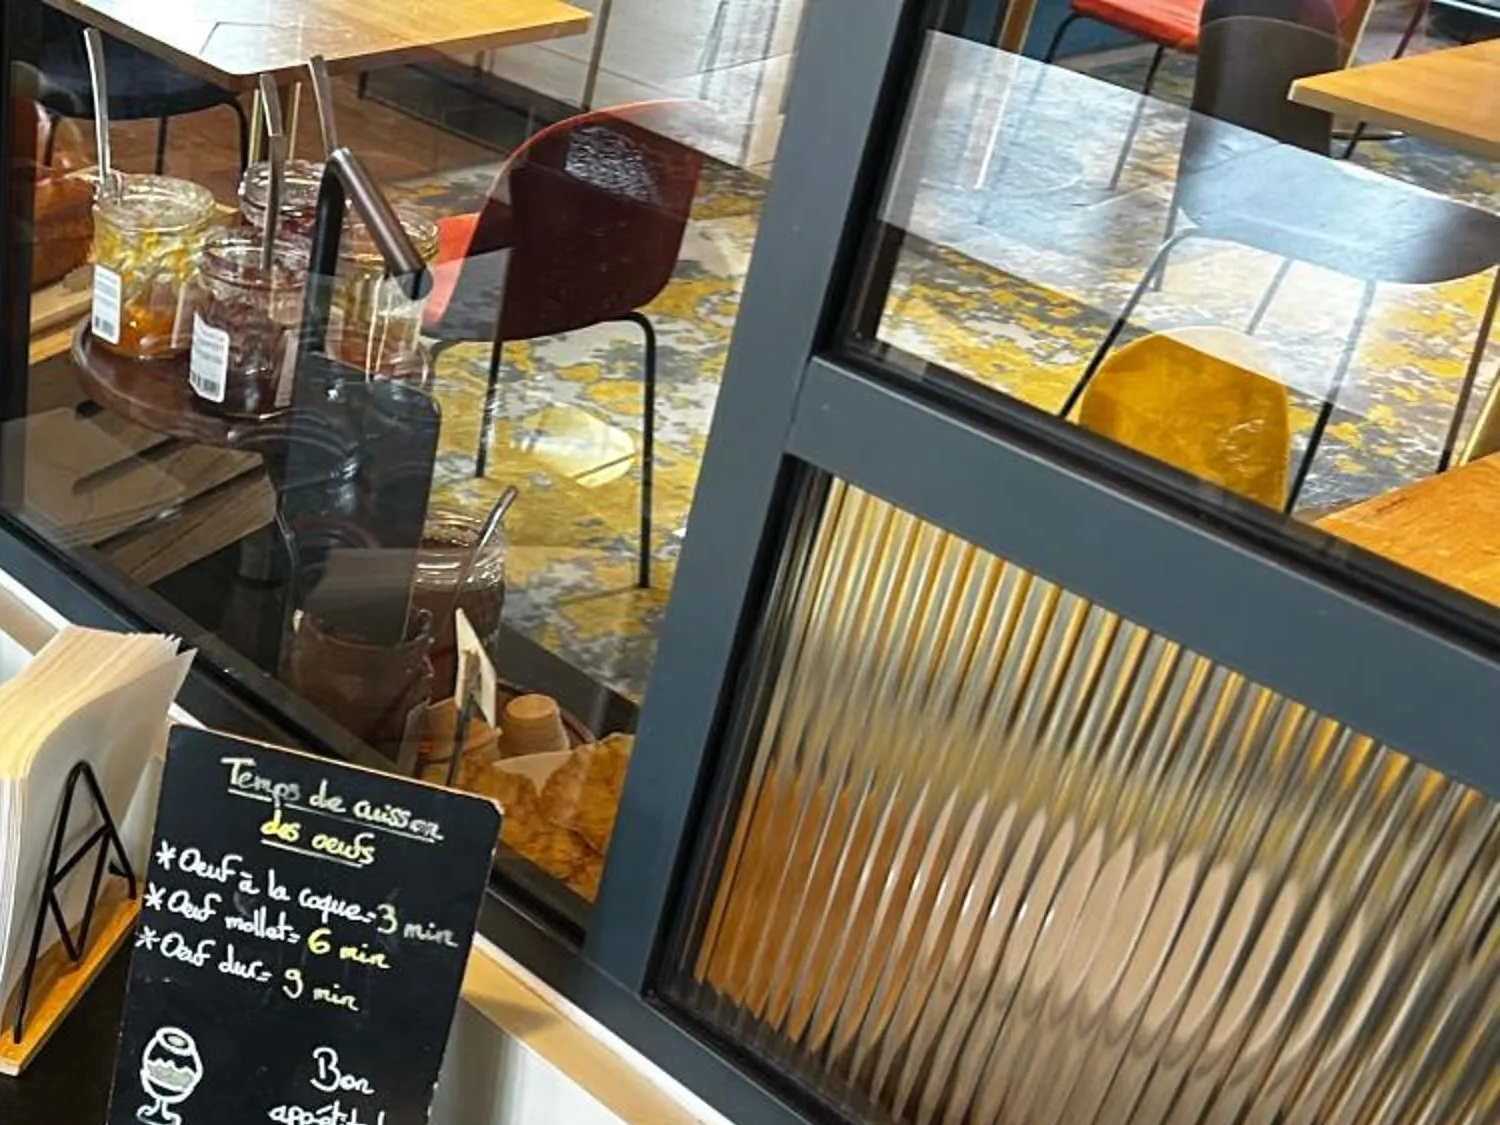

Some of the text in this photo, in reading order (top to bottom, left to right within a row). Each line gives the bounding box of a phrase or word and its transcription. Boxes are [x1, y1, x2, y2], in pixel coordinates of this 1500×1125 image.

[220, 757, 444, 841] Temps de cuisson
[260, 808, 375, 865] des oeufs
[268, 868, 291, 901] la
[403, 921, 459, 948] min
[307, 927, 332, 955] 6
[339, 943, 392, 969] min
[282, 968, 303, 999] 9
[312, 983, 360, 1012] min
[310, 1046, 375, 1095] Bon
